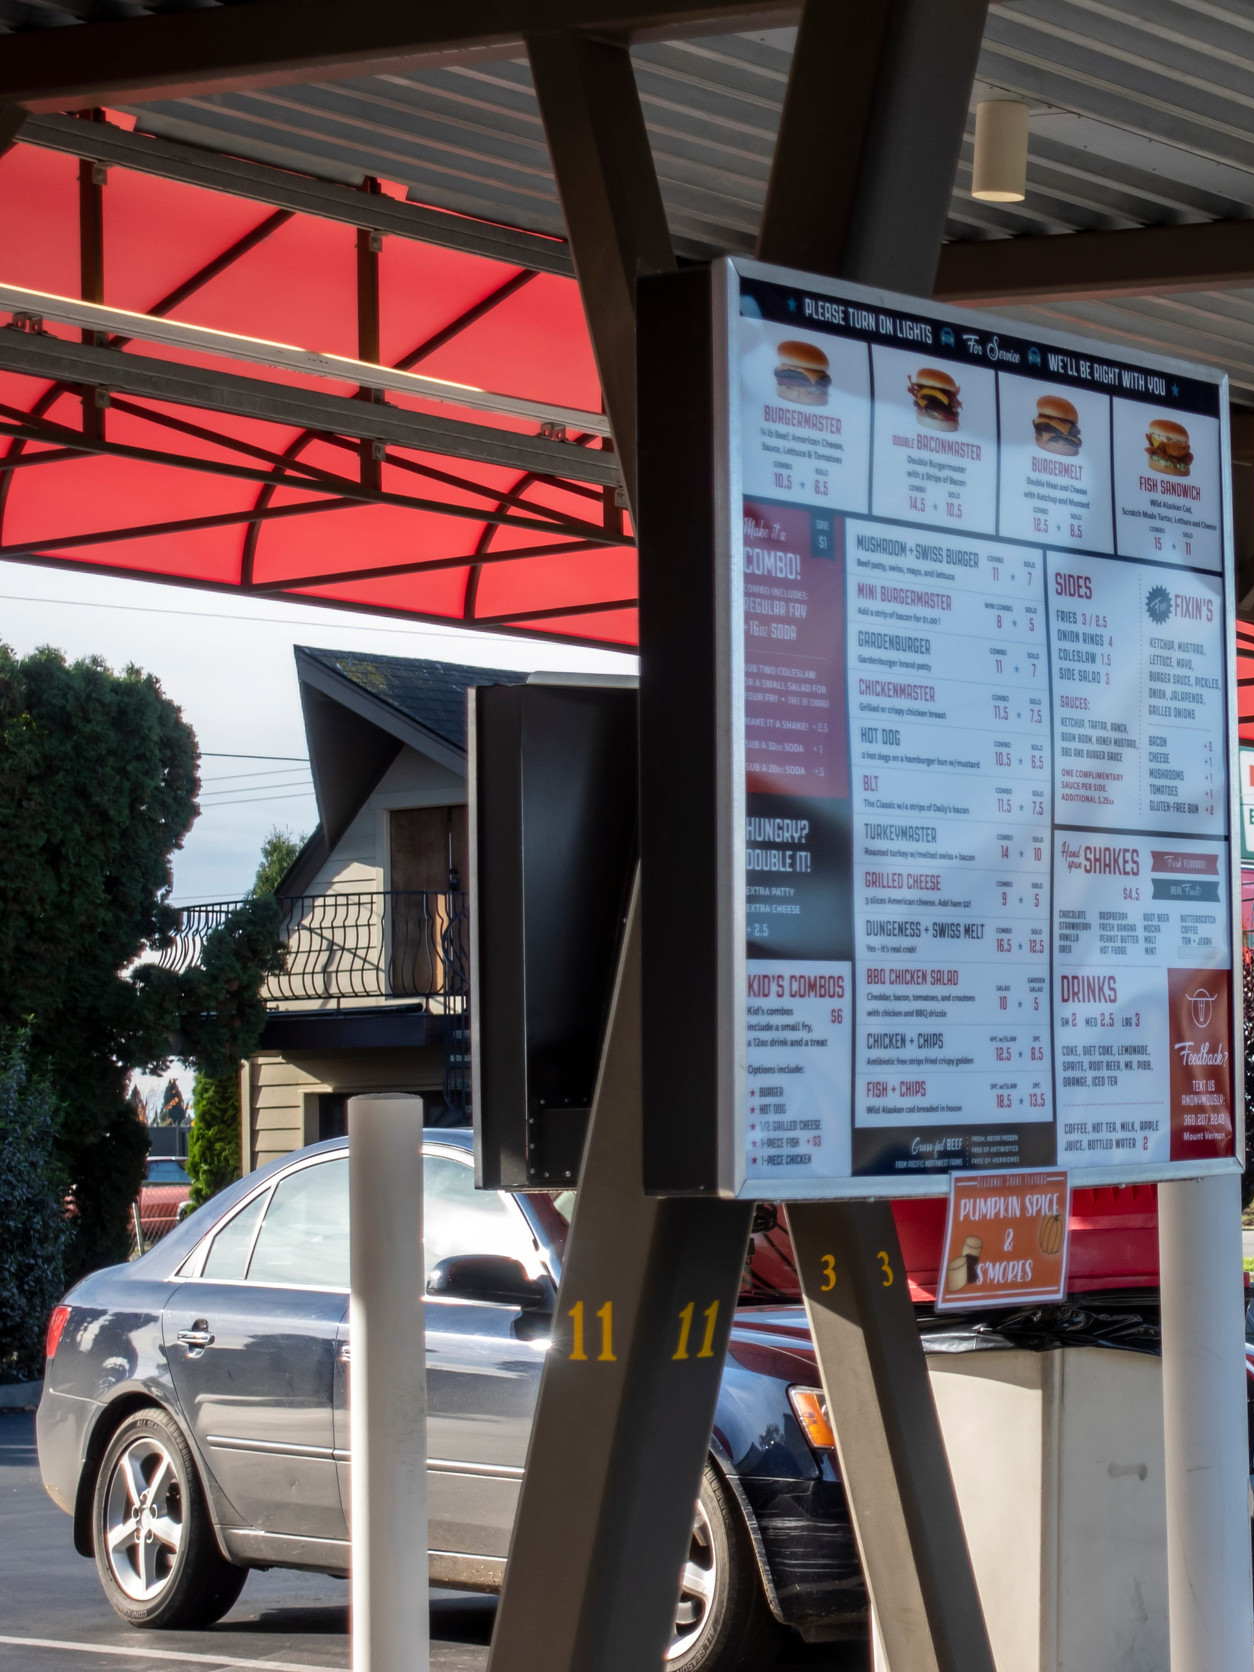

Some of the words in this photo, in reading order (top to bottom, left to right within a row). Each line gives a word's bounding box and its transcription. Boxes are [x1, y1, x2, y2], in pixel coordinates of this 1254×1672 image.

[805, 297, 845, 325] PLEASE
[848, 307, 875, 332] TURN
[879, 315, 893, 336] ON
[897, 318, 932, 344] LIGHTS
[962, 332, 982, 356] For
[987, 333, 1020, 366] Service
[1048, 352, 1077, 377] WE'LL
[1080, 360, 1091, 379] BE
[1094, 363, 1119, 385] RIGHT
[1121, 369, 1144, 391] WITH
[1147, 375, 1165, 396] YOU
[763, 403, 841, 436] BURGERMASTER
[892, 434, 915, 449] DOUBLE
[916, 433, 981, 462] BACONMASTER
[1031, 456, 1082, 481] BURGERMELT
[774, 472, 792, 490] 10.5
[814, 479, 829, 496] 6.5
[1138, 475, 1158, 494] FISH
[1160, 479, 1201, 502] SANDWICH
[908, 495, 925, 512] 14.5
[945, 502, 962, 519] 10.5
[816, 520, 829, 530] SAVE
[1033, 516, 1048, 533] 12.5
[1069, 523, 1082, 539] 8.5
[818, 535, 827, 549] $1
[856, 533, 907, 558] MUSHROOM
[915, 543, 943, 563] SWISS
[945, 547, 979, 568] BURGER
[1153, 537, 1162, 550] 15
[1184, 542, 1191, 555] 11
[743, 546, 801, 580] COMBO!
[857, 582, 877, 601] MINI
[880, 585, 952, 611] BURGERMASTER
[1055, 571, 1092, 600] SIDES
[1056, 609, 1077, 624] FRIES
[1081, 612, 1087, 625] 3
[1095, 615, 1107, 628] 2.5
[1174, 593, 1213, 622] FIXIN'S
[857, 630, 931, 656] GARDENBURGER
[1057, 628, 1080, 643] ONION
[1082, 631, 1104, 646] RINGS
[1108, 635, 1112, 647] 4
[1058, 647, 1096, 664] COLESLAW
[1101, 653, 1111, 666] 1.5
[1059, 666, 1075, 681] SIDE
[1078, 669, 1100, 684] SALAD
[1105, 672, 1109, 685] 3
[858, 678, 935, 702] CHICKENMASTER
[860, 726, 878, 744] HOT
[881, 728, 900, 746] DOG
[994, 751, 1011, 767] 10.5
[1031, 754, 1043, 770] 6.5
[862, 774, 879, 792] BLT
[1149, 799, 1186, 813] GLUTEN-FREE
[1187, 803, 1199, 814] BUN
[745, 816, 809, 843] HUNGRY?
[863, 823, 937, 843] TURKEYMASTER
[745, 848, 792, 871] DOUBLE
[796, 851, 810, 872] IT!
[1083, 845, 1139, 876] SHAKES
[864, 871, 903, 889] GRILLED
[906, 873, 941, 891] CHEESE
[1123, 887, 1140, 900] $4.5
[865, 919, 921, 938] DUNGENESS
[932, 922, 961, 939] SWISS
[963, 923, 984, 939] MELT
[995, 938, 1011, 953] 16.5
[1028, 939, 1044, 953] 12.5
[747, 973, 784, 997] KID'S
[788, 974, 844, 998] COMBOS
[866, 968, 885, 984] BBQ
[888, 968, 927, 985] CHICKEN
[930, 969, 958, 986] SALAD
[1060, 974, 1117, 1003] DRINKS
[866, 992, 892, 1002] Cheddar,
[893, 993, 911, 1003] bacon,
[912, 993, 939, 1003] tomatoes,
[940, 993, 951, 1002] and
[951, 993, 975, 1002] croutons
[830, 1008, 842, 1024] $6
[866, 1032, 906, 1049] CHICKEN
[917, 1032, 943, 1049] CHIPS
[995, 1047, 1011, 1061] 12.5
[1030, 1046, 1043, 1061] 8.5
[1174, 1040, 1228, 1068] Feedback?
[866, 1081, 888, 1098] FISH
[899, 1080, 926, 1097] CHIPS
[1192, 1080, 1206, 1092] TEXT
[1207, 1080, 1215, 1091] US
[1183, 1131, 1203, 1141] Mount
[1204, 1130, 1225, 1140] Vernon
[960, 1195, 1020, 1221] PUMPKIN
[1025, 1193, 1059, 1217] SPICE
[1004, 1228, 1014, 1252] &
[820, 1254, 837, 1291] 3
[877, 1251, 894, 1287] 3
[976, 1259, 1033, 1286] S'MORES
[568, 1300, 617, 1361] 11
[672, 1300, 720, 1360] 11
